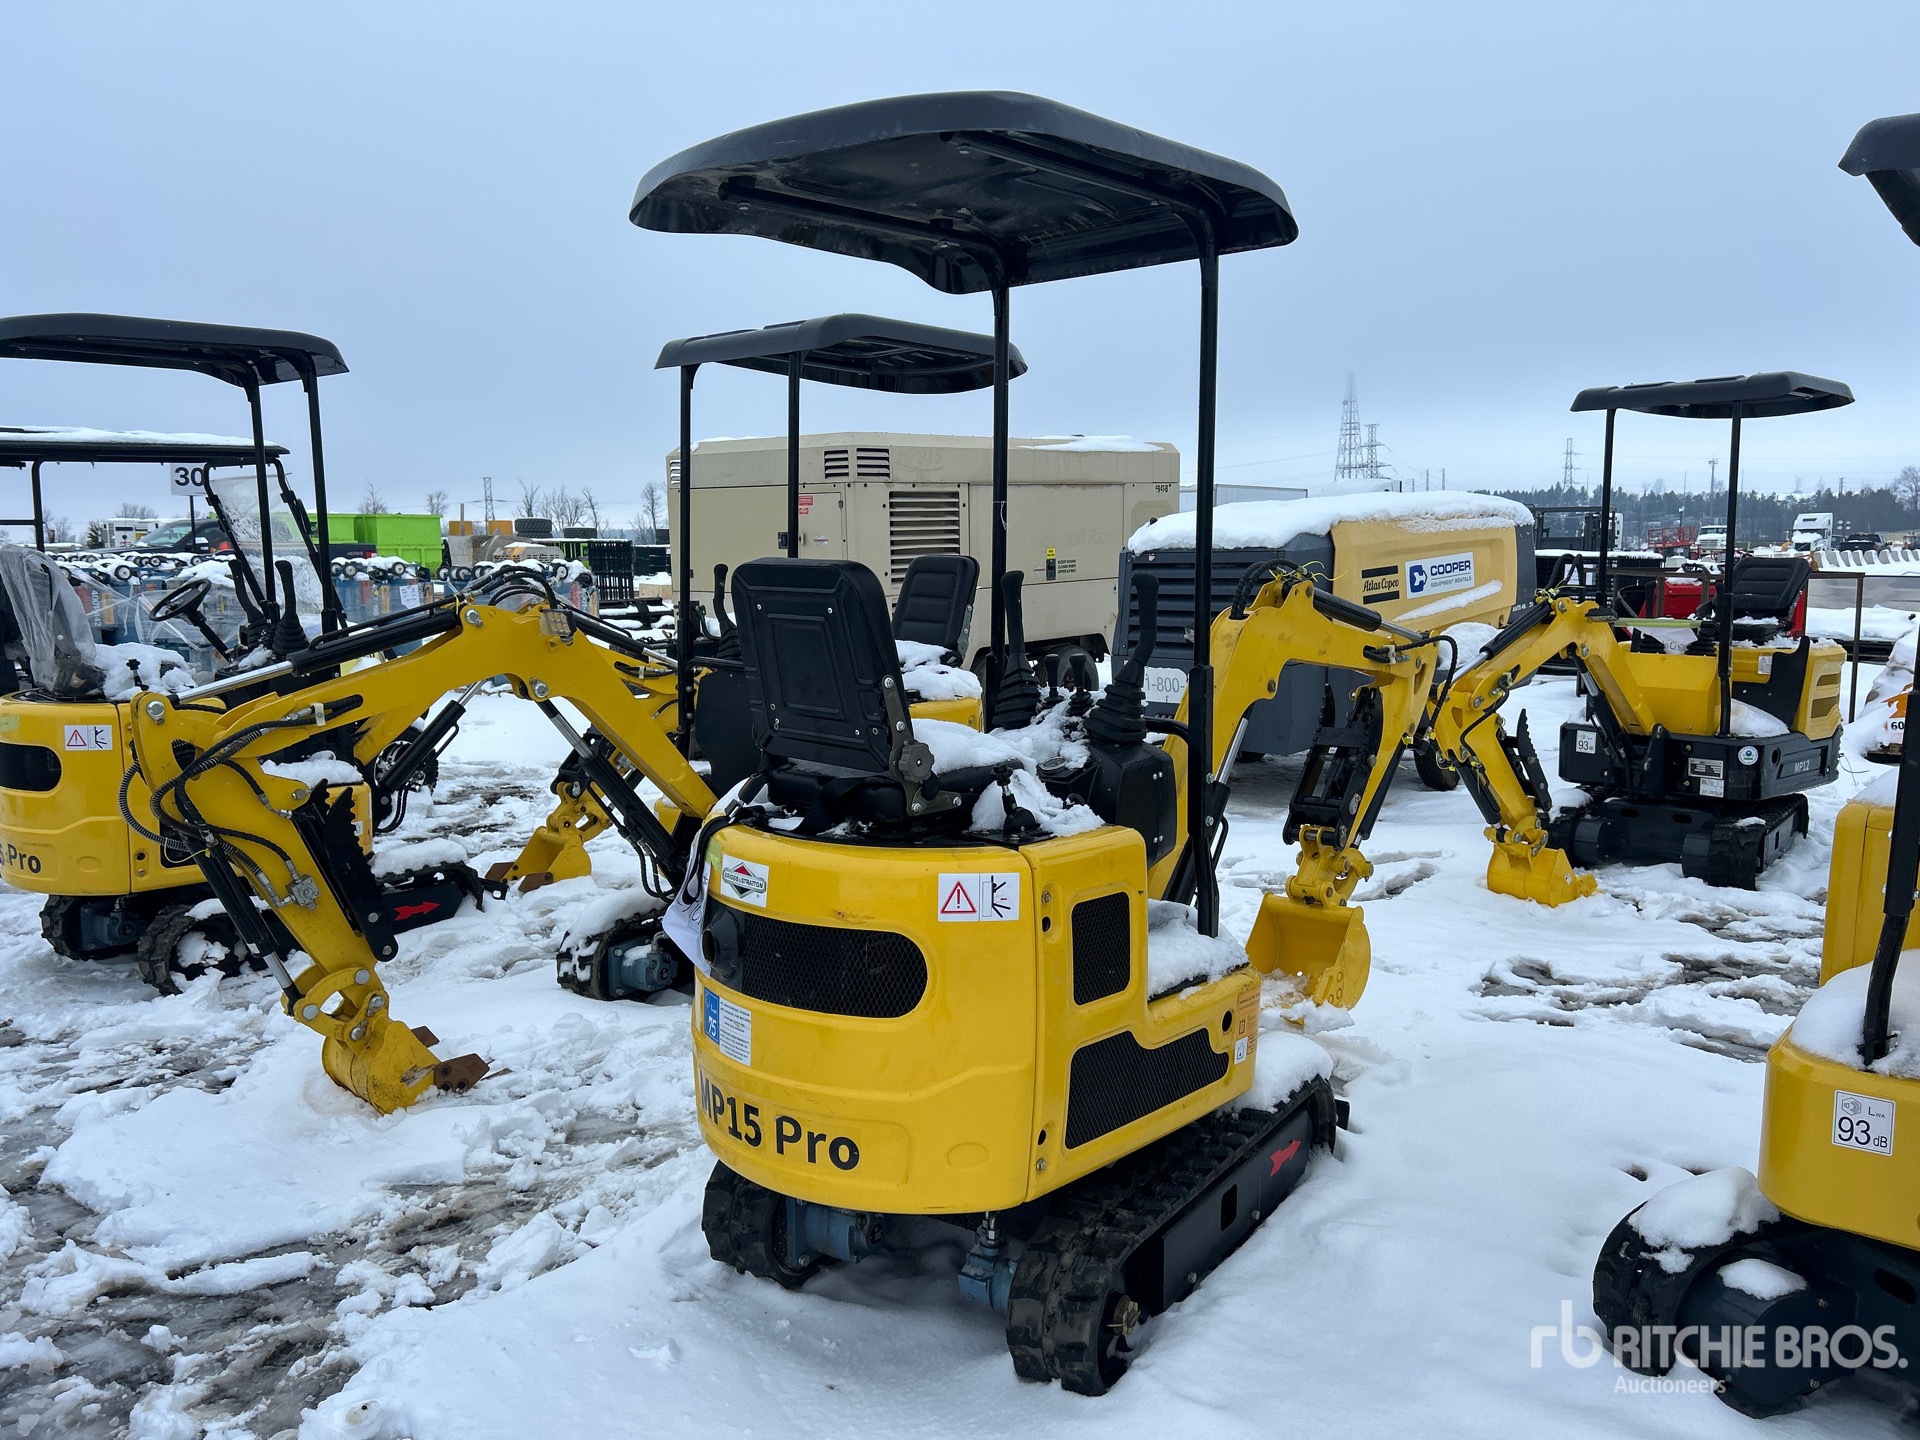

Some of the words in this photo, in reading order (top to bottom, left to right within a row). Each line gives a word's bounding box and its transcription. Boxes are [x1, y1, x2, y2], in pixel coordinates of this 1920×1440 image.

[174, 466, 205, 487] 30
[1430, 560, 1471, 576] COOPER
[1363, 580, 1381, 592] Atlas
[1381, 578, 1399, 590] Copco
[1430, 579, 1454, 588] EQUIPMENT
[1454, 576, 1472, 585] RENTALS
[1578, 740, 1589, 751] 93
[1794, 760, 1810, 773] MP12
[7, 843, 42, 874] Pro
[708, 1015, 717, 1037] 75
[699, 1069, 762, 1147] MP15
[775, 1115, 860, 1171] Pro
[1838, 1116, 1871, 1146] 93
[1873, 1135, 1888, 1148] dB
